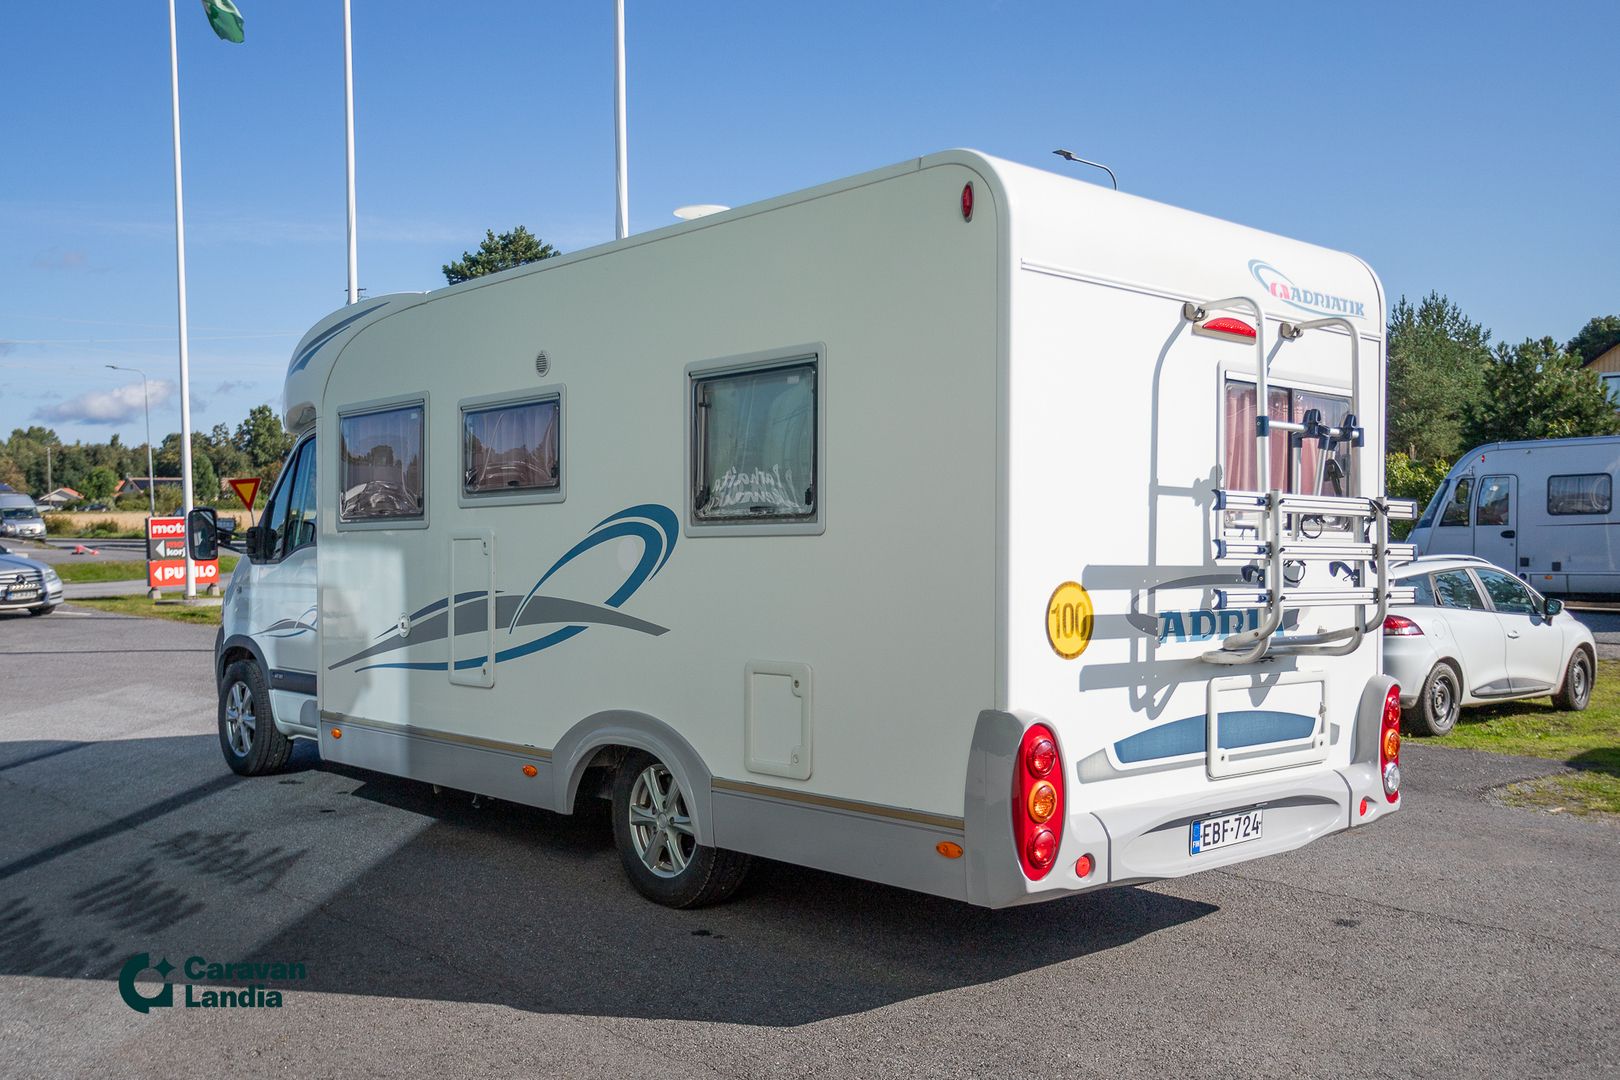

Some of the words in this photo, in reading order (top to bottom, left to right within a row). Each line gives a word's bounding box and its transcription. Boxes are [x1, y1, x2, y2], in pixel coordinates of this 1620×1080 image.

[1290, 287, 1365, 316] ADRIATIK
[164, 565, 216, 580] PUILO
[1051, 602, 1086, 640] 100
[1202, 813, 1260, 847] EBF-724
